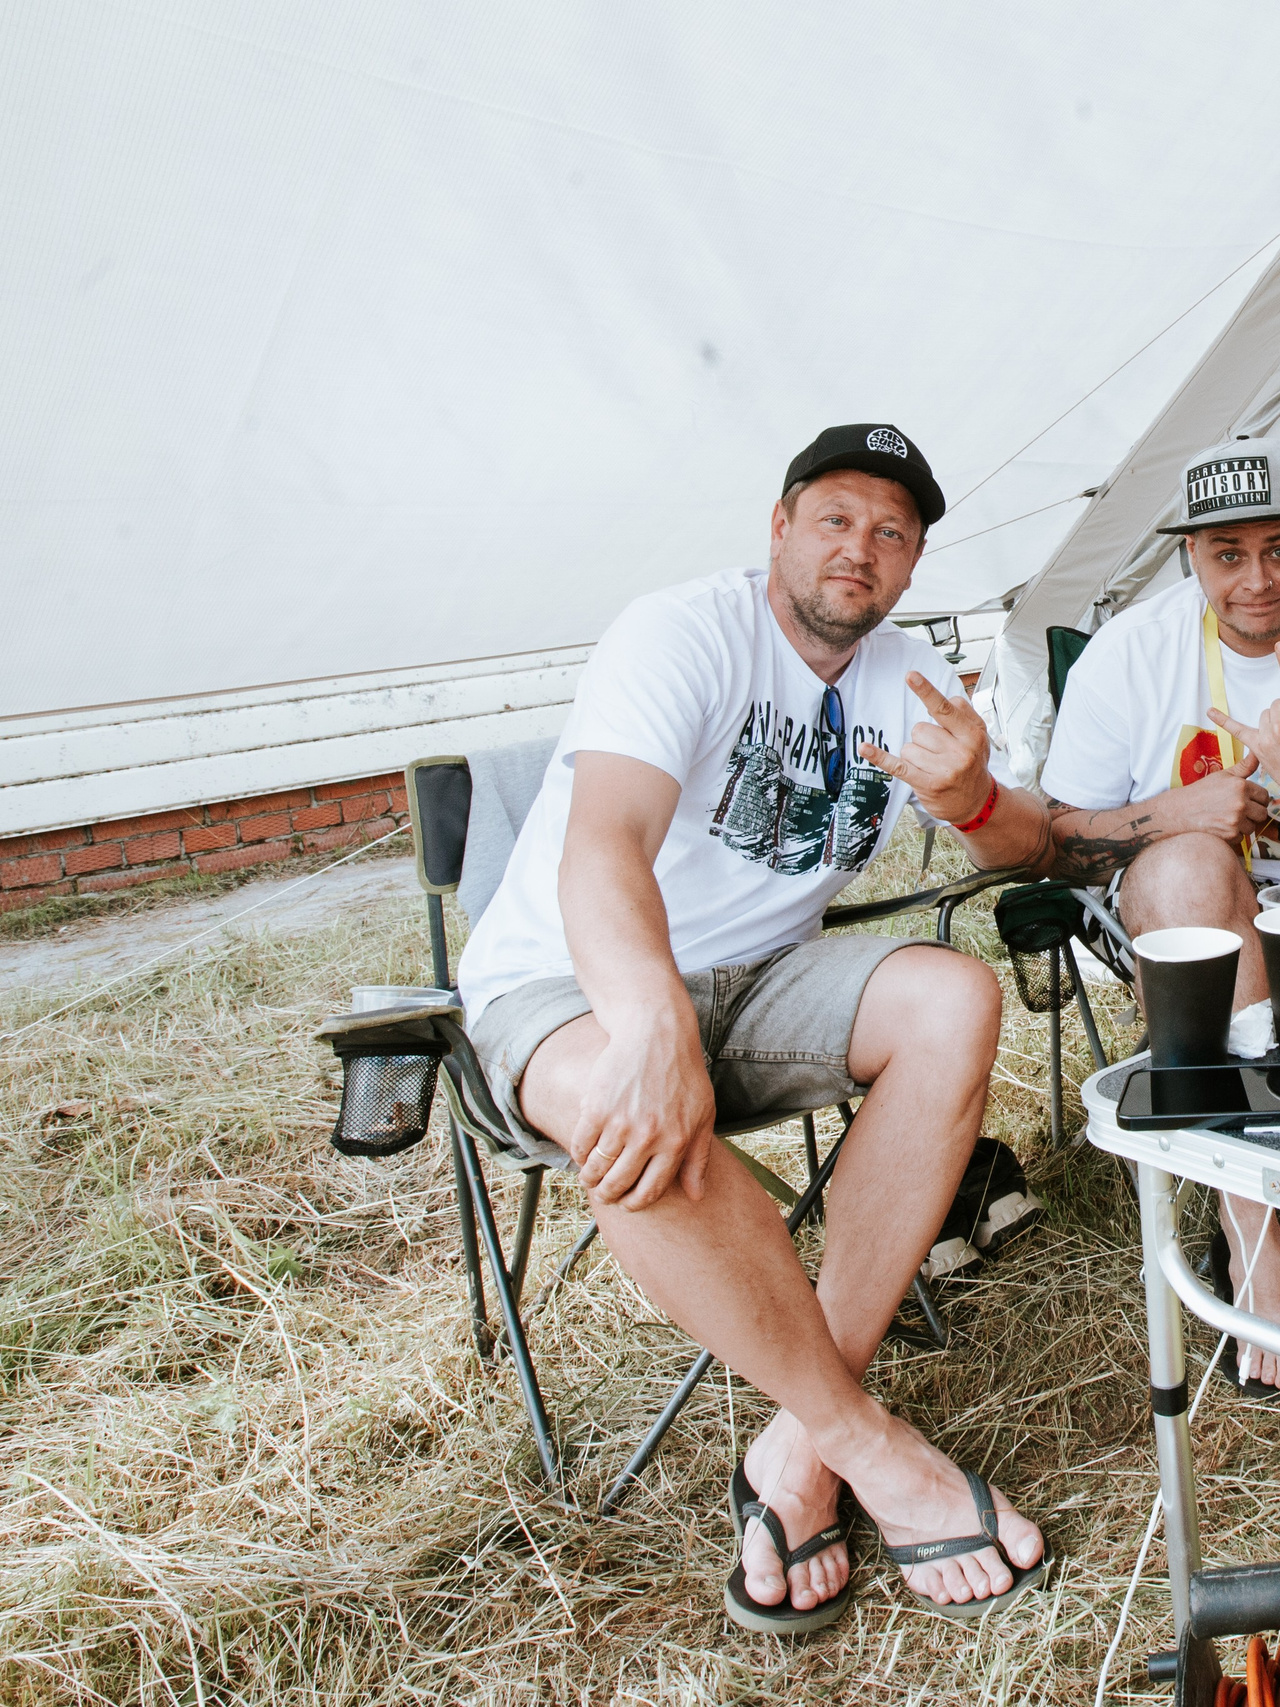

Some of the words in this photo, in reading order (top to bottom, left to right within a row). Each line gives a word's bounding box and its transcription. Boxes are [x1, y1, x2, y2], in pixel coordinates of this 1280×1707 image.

[872, 430, 903, 445] RIP
[868, 436, 906, 456] CURL
[1190, 460, 1263, 481] PARENTAL
[1225, 492, 1266, 505] CONTENT
[916, 1543, 946, 1559] fipper
